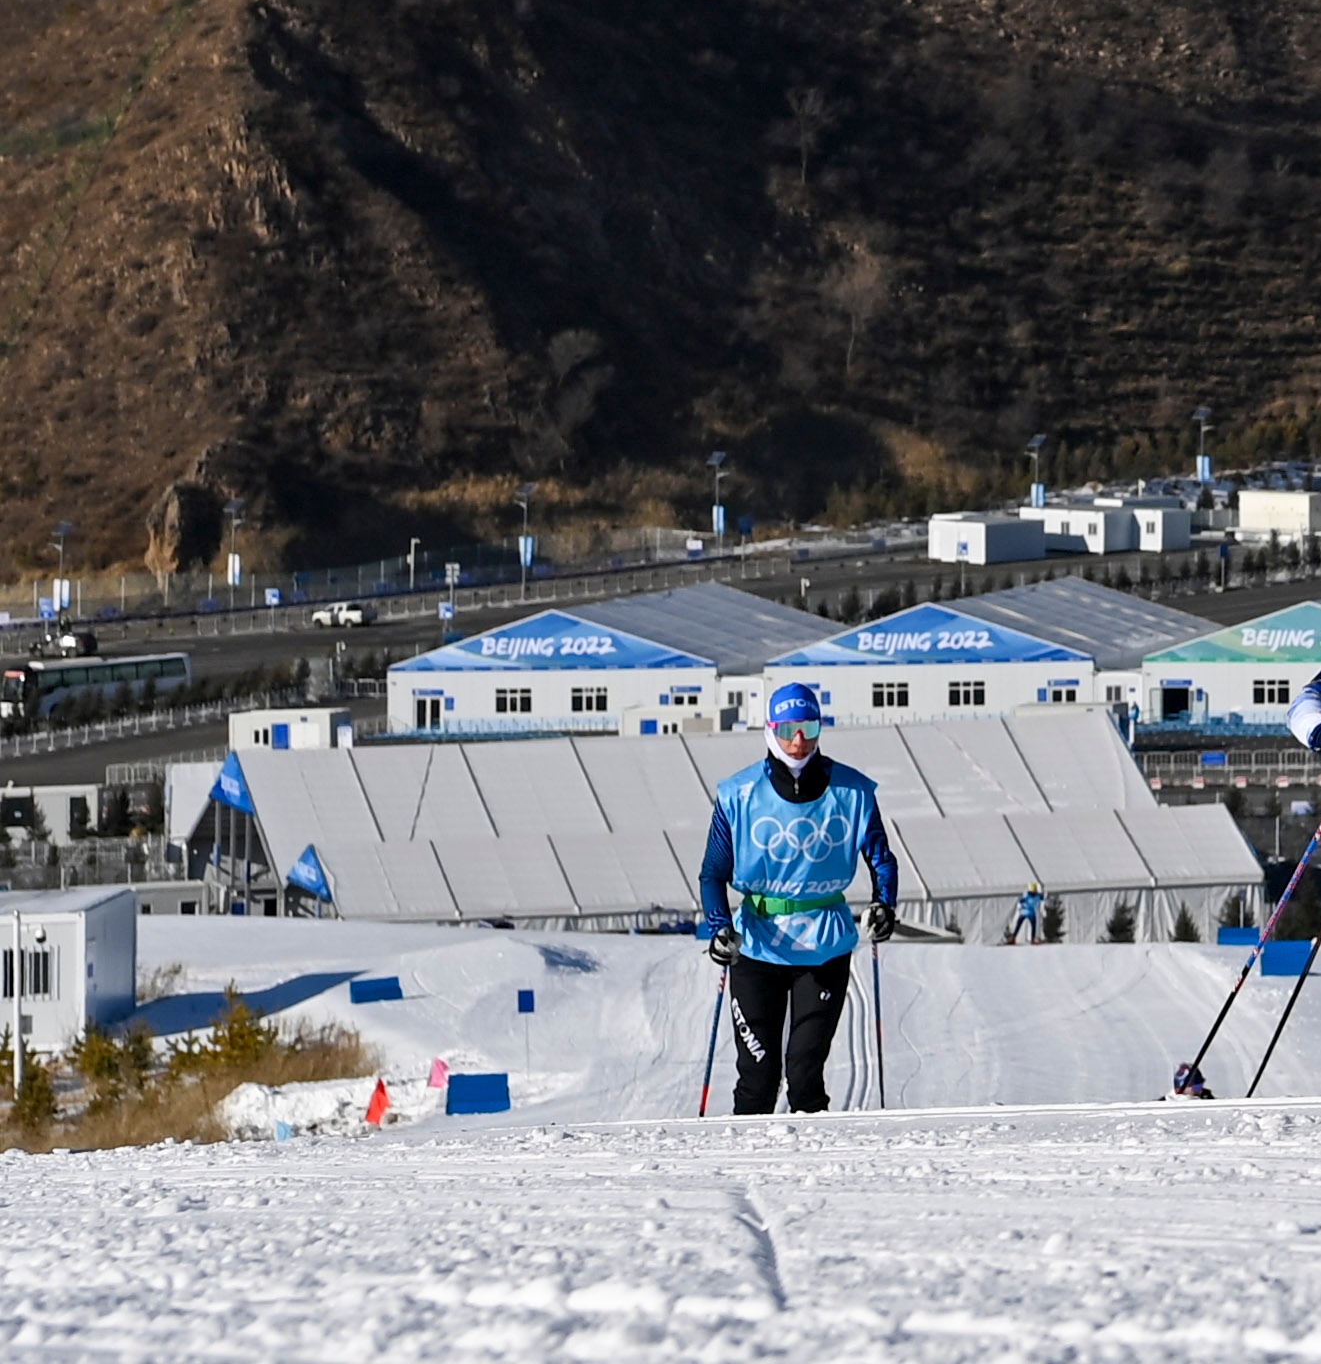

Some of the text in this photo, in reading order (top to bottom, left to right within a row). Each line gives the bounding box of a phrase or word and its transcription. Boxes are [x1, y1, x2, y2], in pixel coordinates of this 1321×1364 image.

[481, 636, 617, 661] BEIJING 2022
[857, 631, 994, 656] BEIJING 2022
[1241, 628, 1315, 652] BEIJING
[731, 997, 766, 1063] ESTONIA
